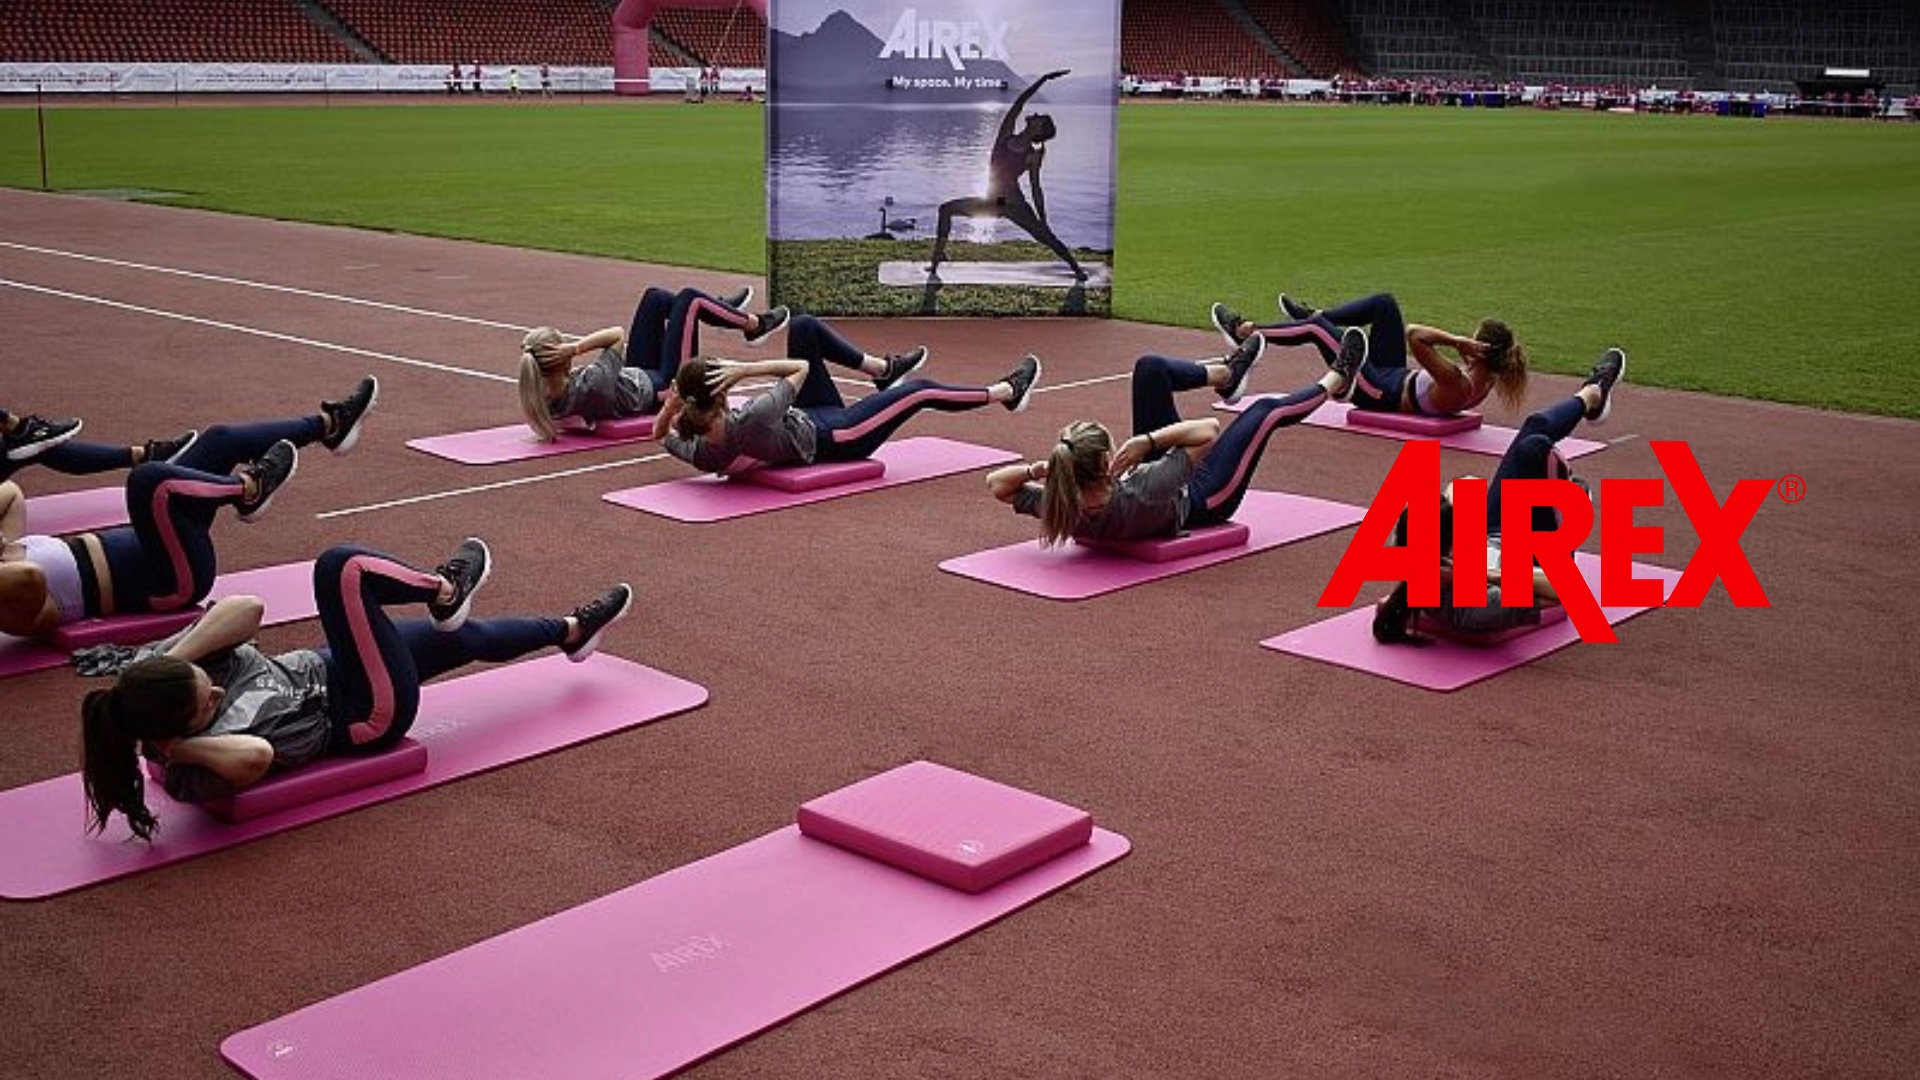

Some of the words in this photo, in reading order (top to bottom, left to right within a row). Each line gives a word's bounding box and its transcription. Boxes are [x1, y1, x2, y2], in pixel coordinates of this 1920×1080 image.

[892, 76, 912, 90] My
[914, 78, 952, 90] space.
[954, 76, 972, 90] My
[974, 76, 1006, 88] time.
